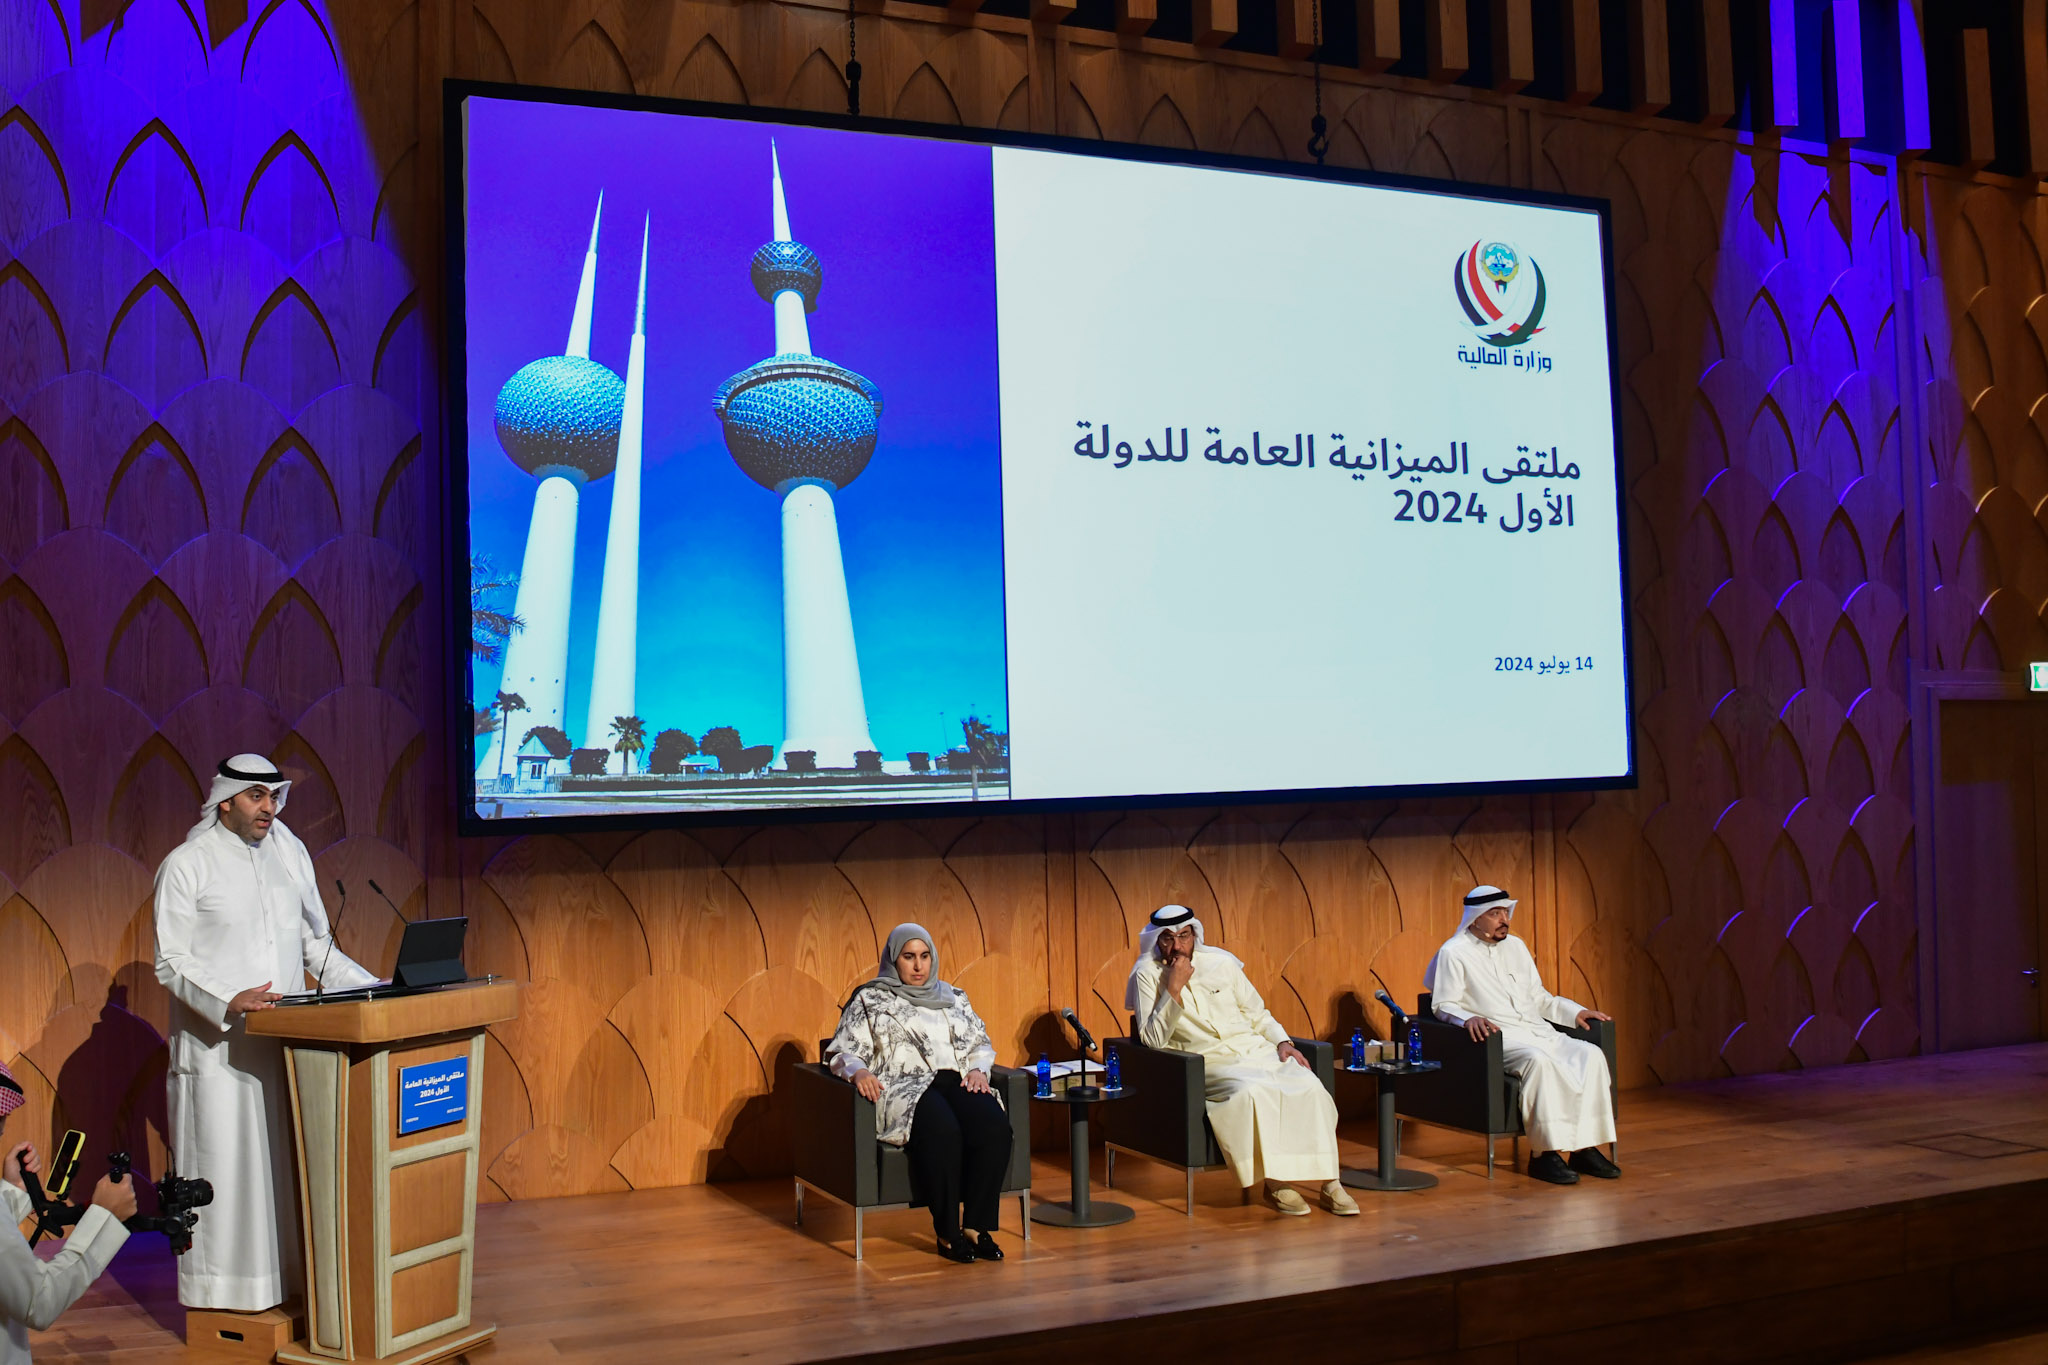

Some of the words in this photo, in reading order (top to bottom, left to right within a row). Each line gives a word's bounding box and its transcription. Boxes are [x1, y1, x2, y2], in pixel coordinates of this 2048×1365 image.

[1457, 345, 1507, 370] المالية
[1513, 349, 1552, 374] وزارة
[1072, 419, 1190, 469] للدولة
[1202, 426, 1315, 469] العامة
[1327, 434, 1470, 483] الميزانية
[1481, 444, 1581, 485] ملتقى
[1393, 488, 1488, 525] 2024
[1498, 487, 1575, 533] الأول
[1494, 656, 1534, 672] 2024
[1536, 654, 1570, 675] يوليو
[1574, 656, 1594, 671] 14
[405, 1079, 422, 1089] العامة
[423, 1074, 446, 1086] الميزانية
[446, 1071, 464, 1082] ملتقى
[420, 1089, 435, 1098] 2024
[435, 1085, 450, 1096] الأول
